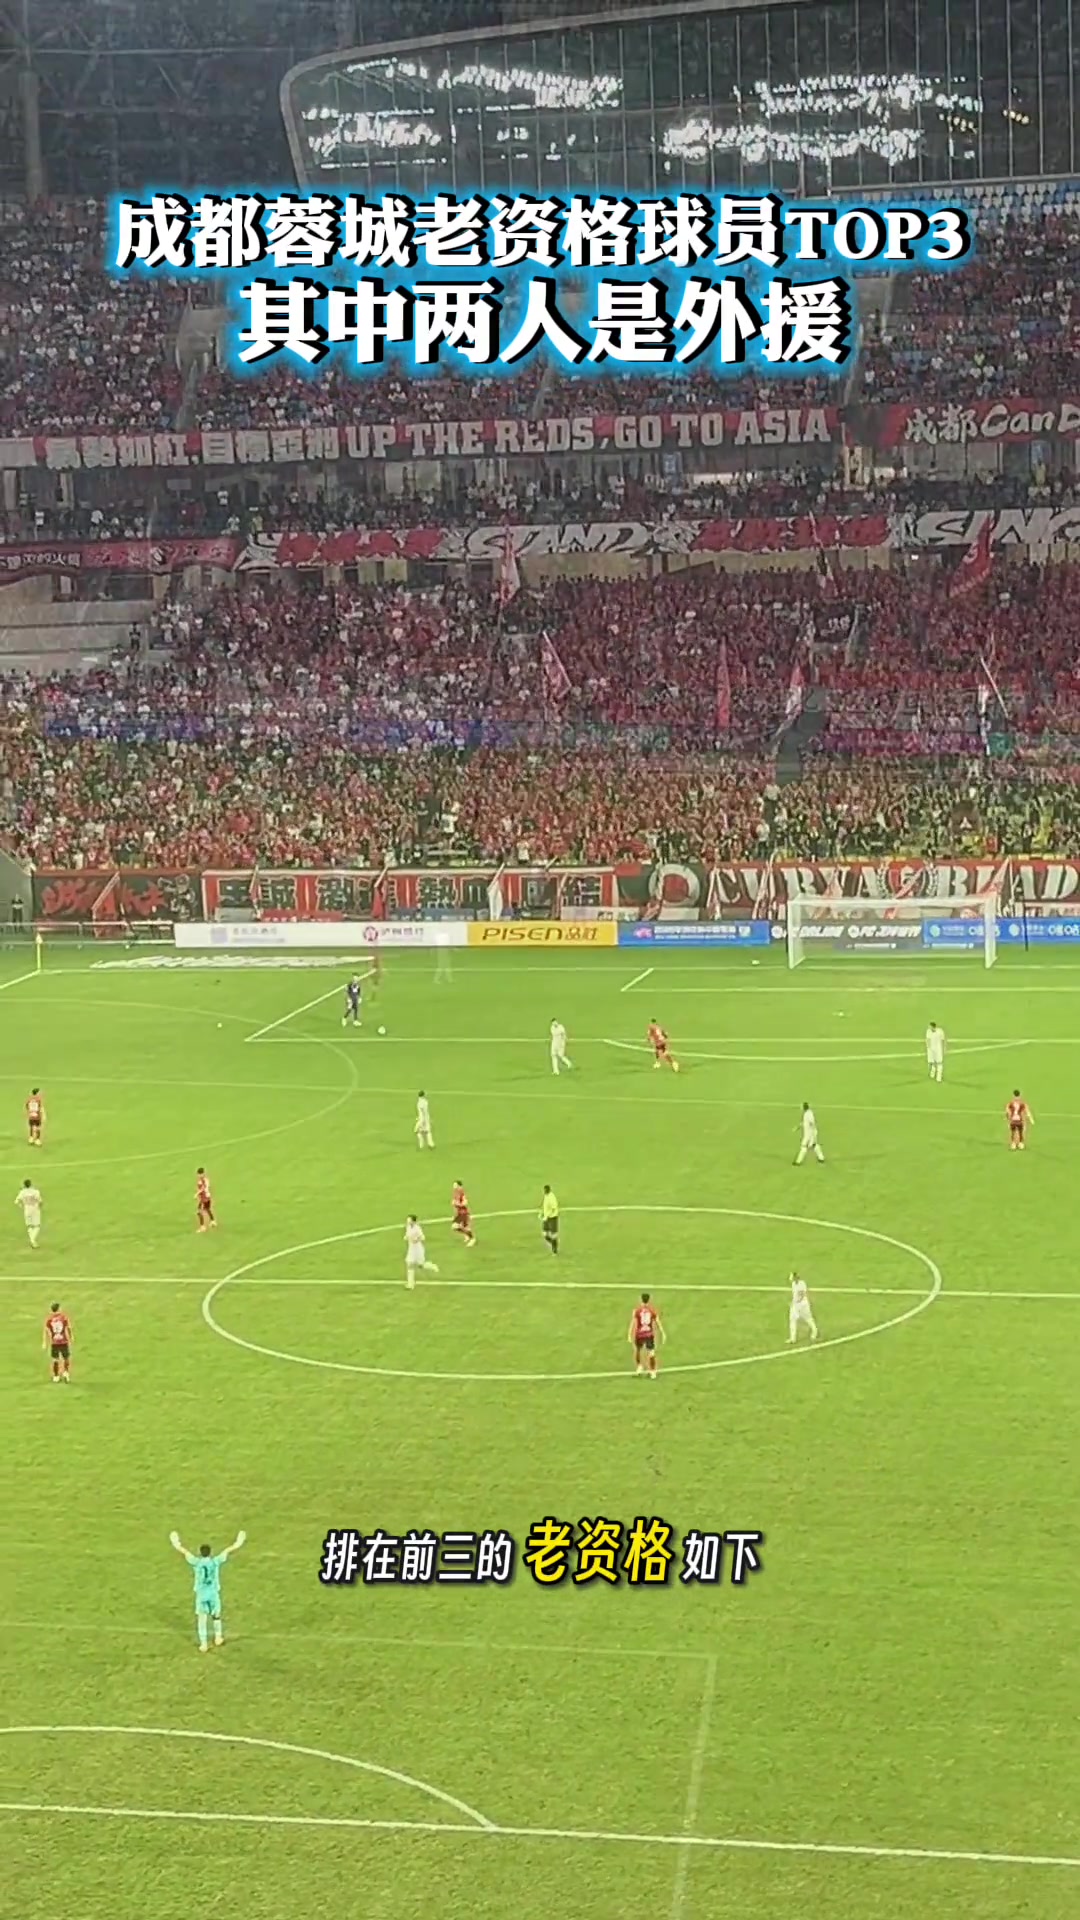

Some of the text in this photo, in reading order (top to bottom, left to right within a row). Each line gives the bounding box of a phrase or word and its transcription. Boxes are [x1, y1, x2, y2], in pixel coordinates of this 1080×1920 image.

[346, 424, 396, 459] UP
[405, 421, 484, 457] THE
[614, 415, 662, 449] GO
[670, 411, 723, 449] TO
[734, 408, 831, 446] ASIA
[482, 927, 562, 940] PISEN
